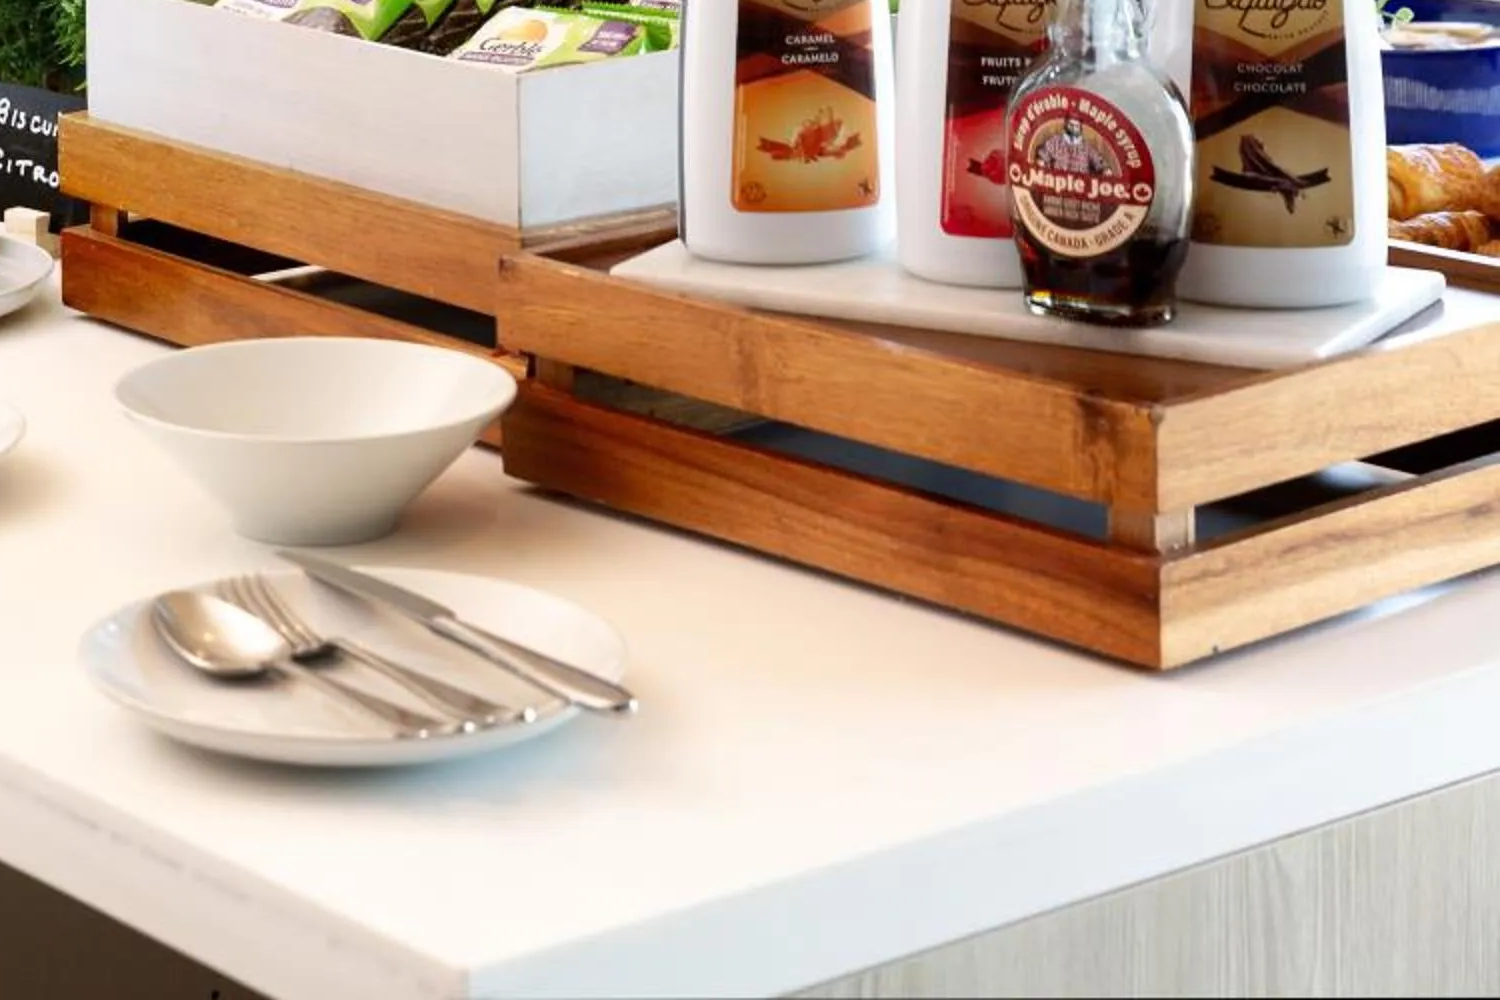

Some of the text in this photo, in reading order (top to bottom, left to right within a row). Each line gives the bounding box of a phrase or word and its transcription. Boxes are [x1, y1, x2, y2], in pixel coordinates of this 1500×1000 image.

[785, 34, 836, 45] CARAMEL
[781, 53, 839, 64] CARAMELO
[980, 56, 1021, 67] FRUITS
[1237, 63, 1303, 74] CHOCOLAT
[1233, 82, 1307, 93] CHOCOLATE
[1079, 98, 1117, 131] Maple
[1022, 169, 1085, 192] Maple
